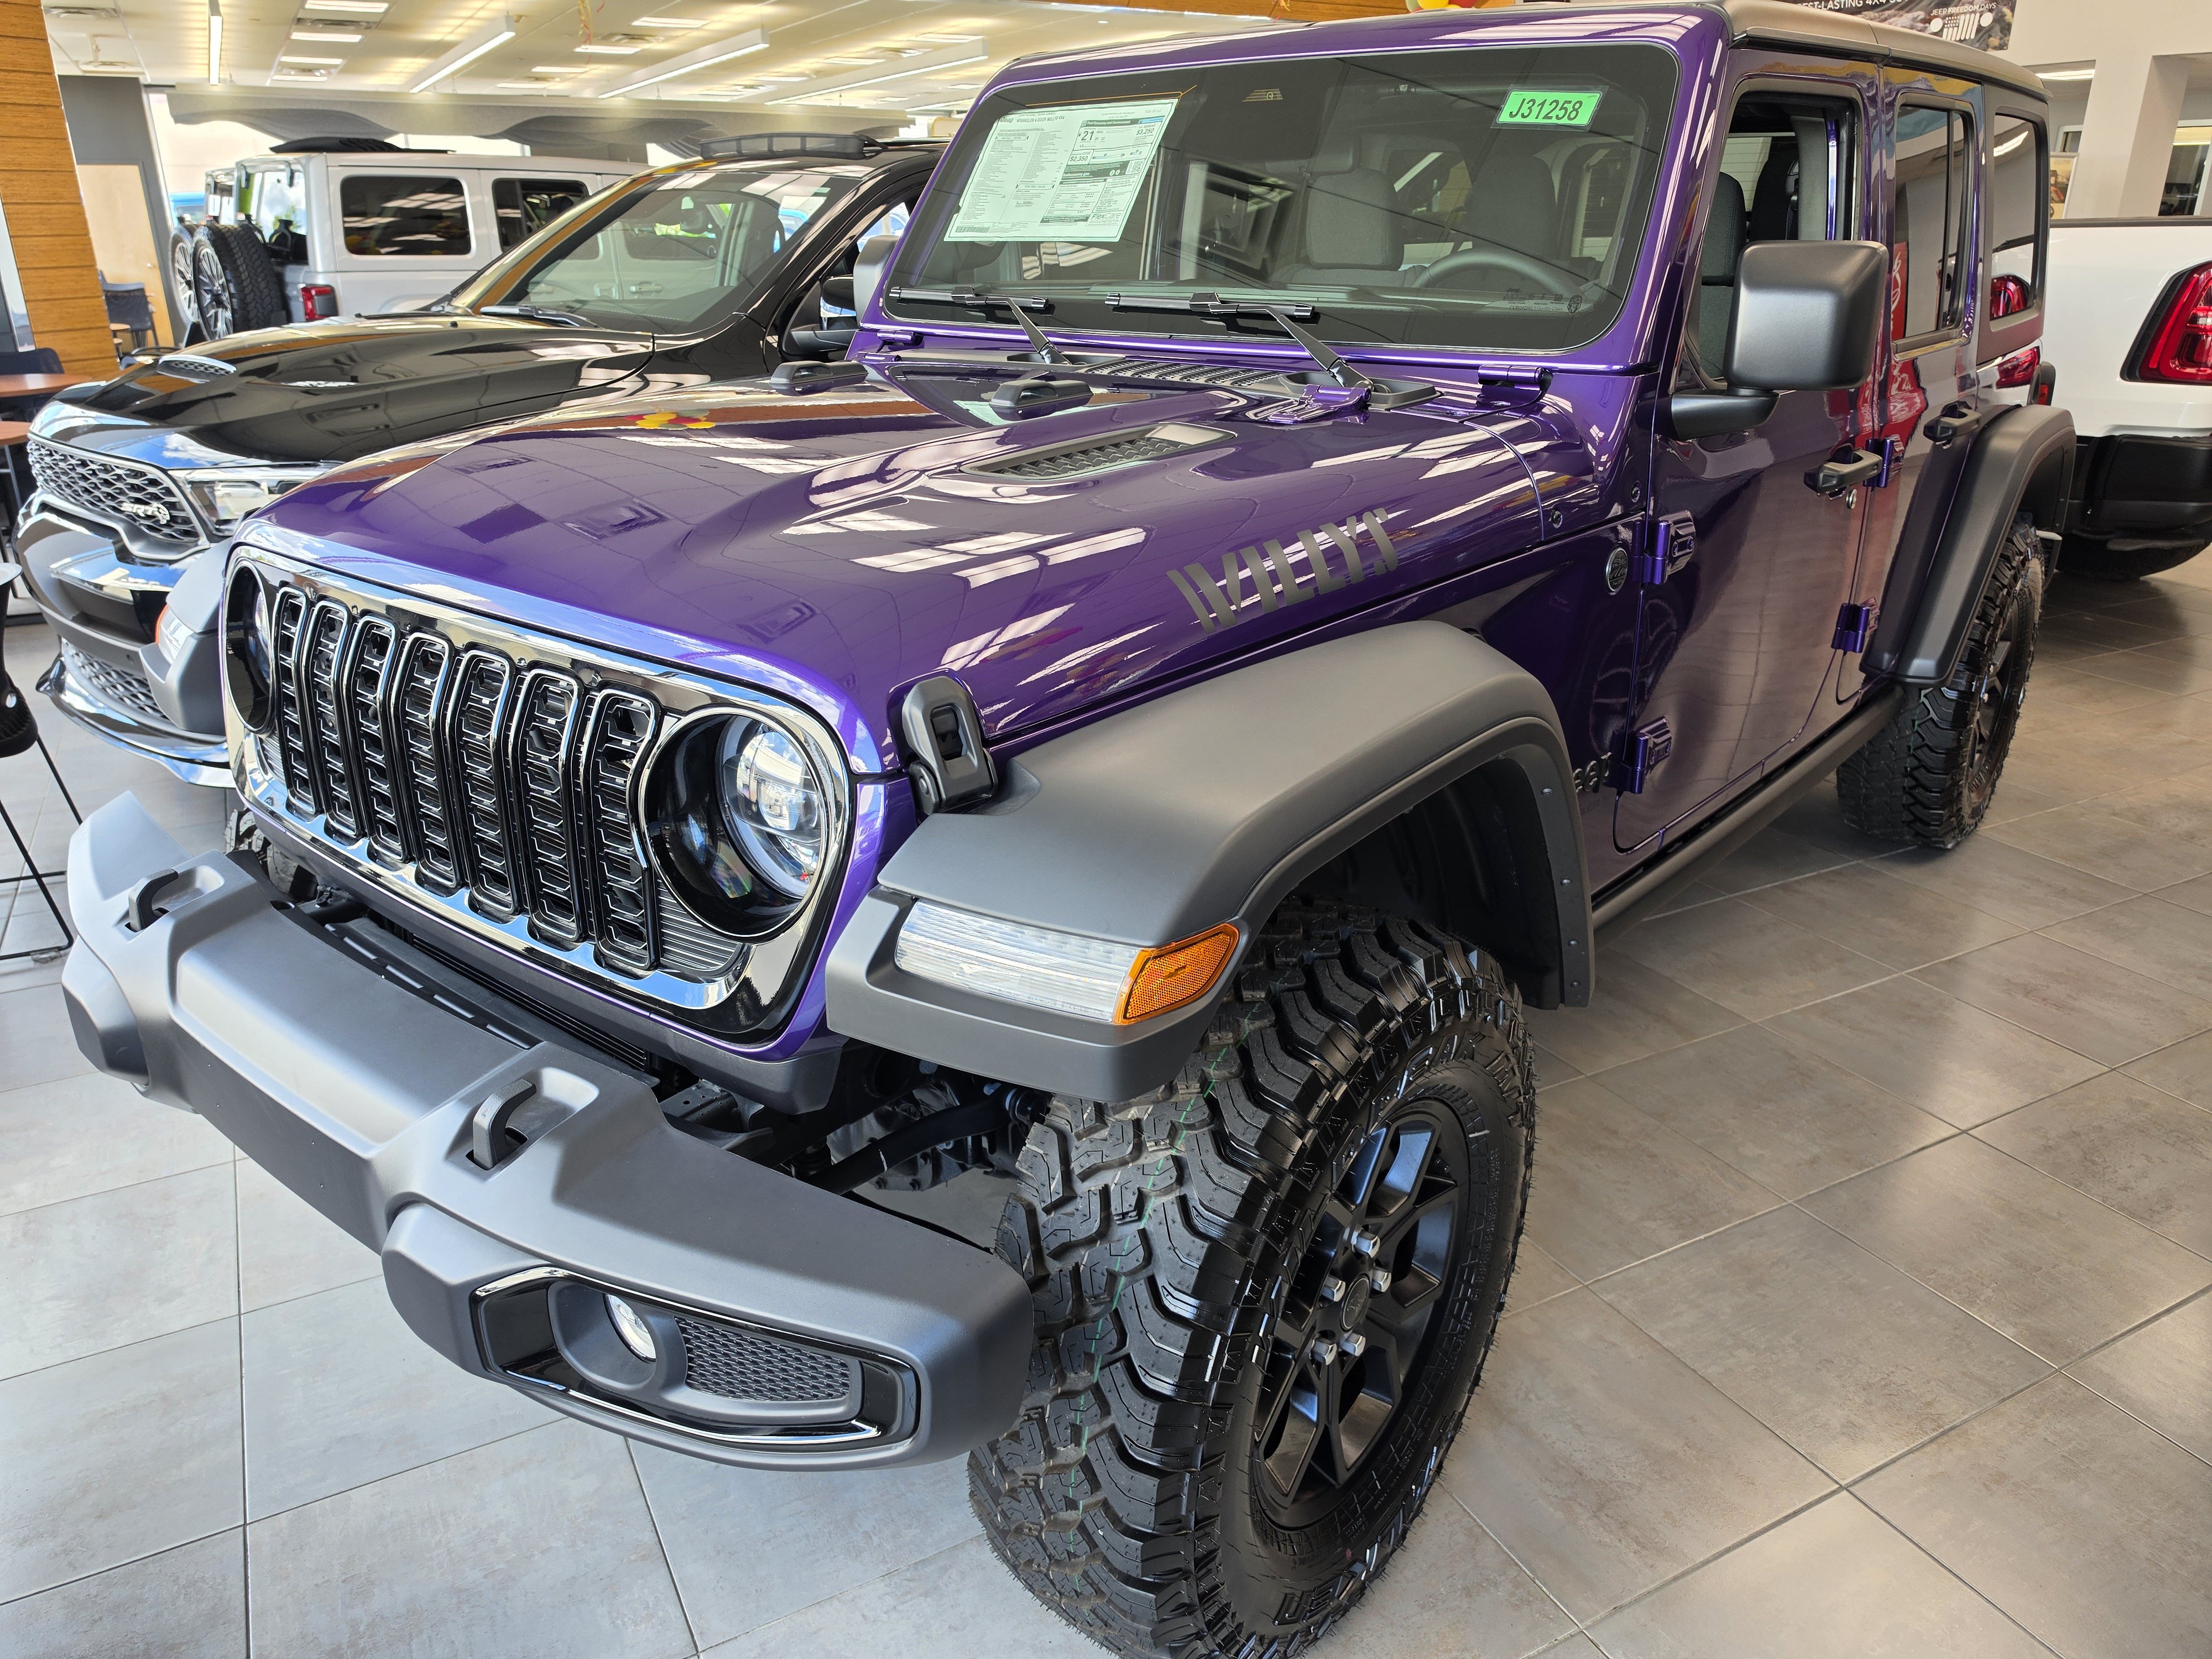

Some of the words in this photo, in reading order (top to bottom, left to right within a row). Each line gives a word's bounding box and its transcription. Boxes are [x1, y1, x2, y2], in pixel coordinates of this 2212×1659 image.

[1797, 0, 1863, 11] ST-LASTING
[1948, 4, 1979, 14] FREEDOM
[1979, 2, 1997, 11] DAYS
[1509, 98, 1583, 121] J31258
[1081, 131, 1095, 140] 21
[121, 502, 158, 517] SRT
[1166, 508, 1398, 633] WILLYS
[1573, 752, 1612, 794] eep
